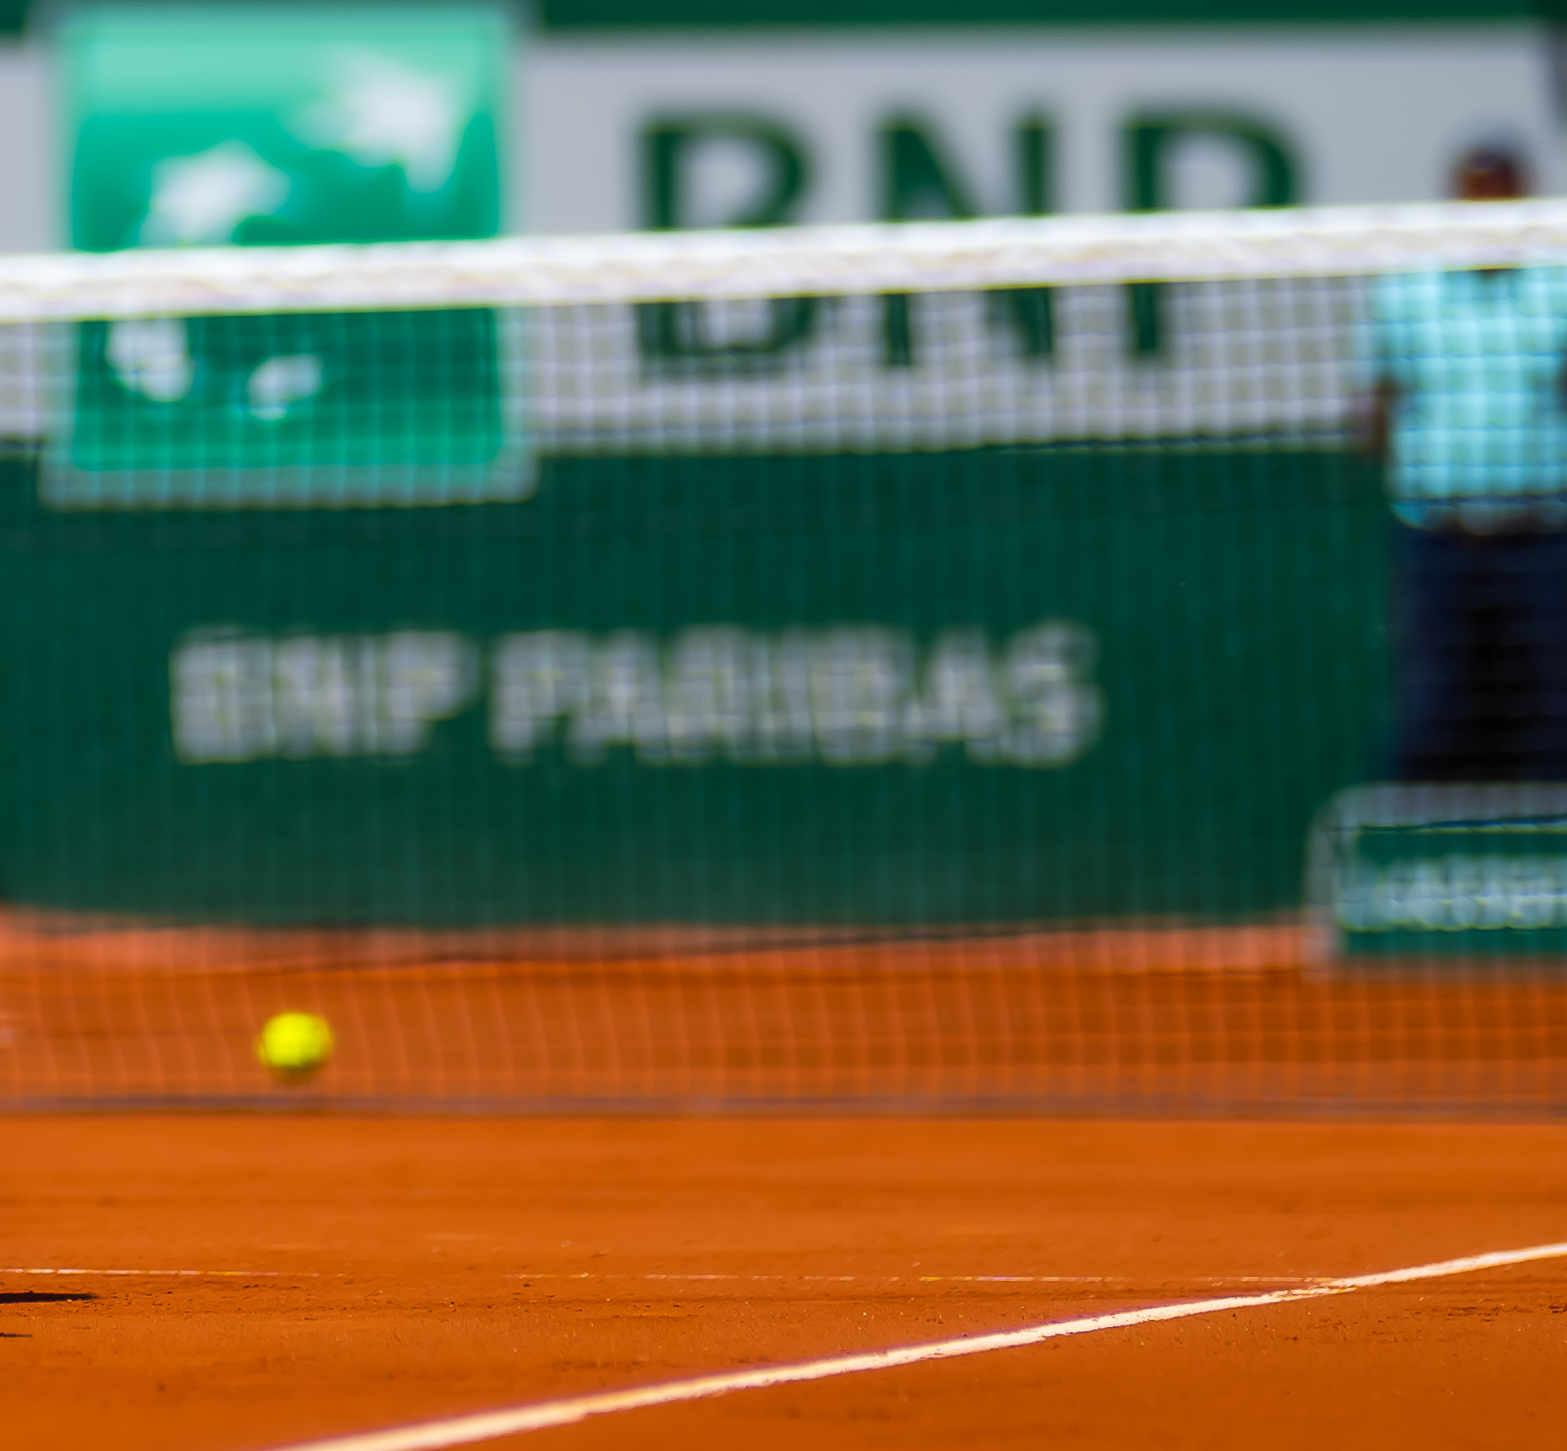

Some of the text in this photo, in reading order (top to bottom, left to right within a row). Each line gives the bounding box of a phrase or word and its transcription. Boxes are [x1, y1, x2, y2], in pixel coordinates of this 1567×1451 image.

[630, 109, 1301, 375] BNP
[170, 625, 1103, 765] BNP PARIBAS
